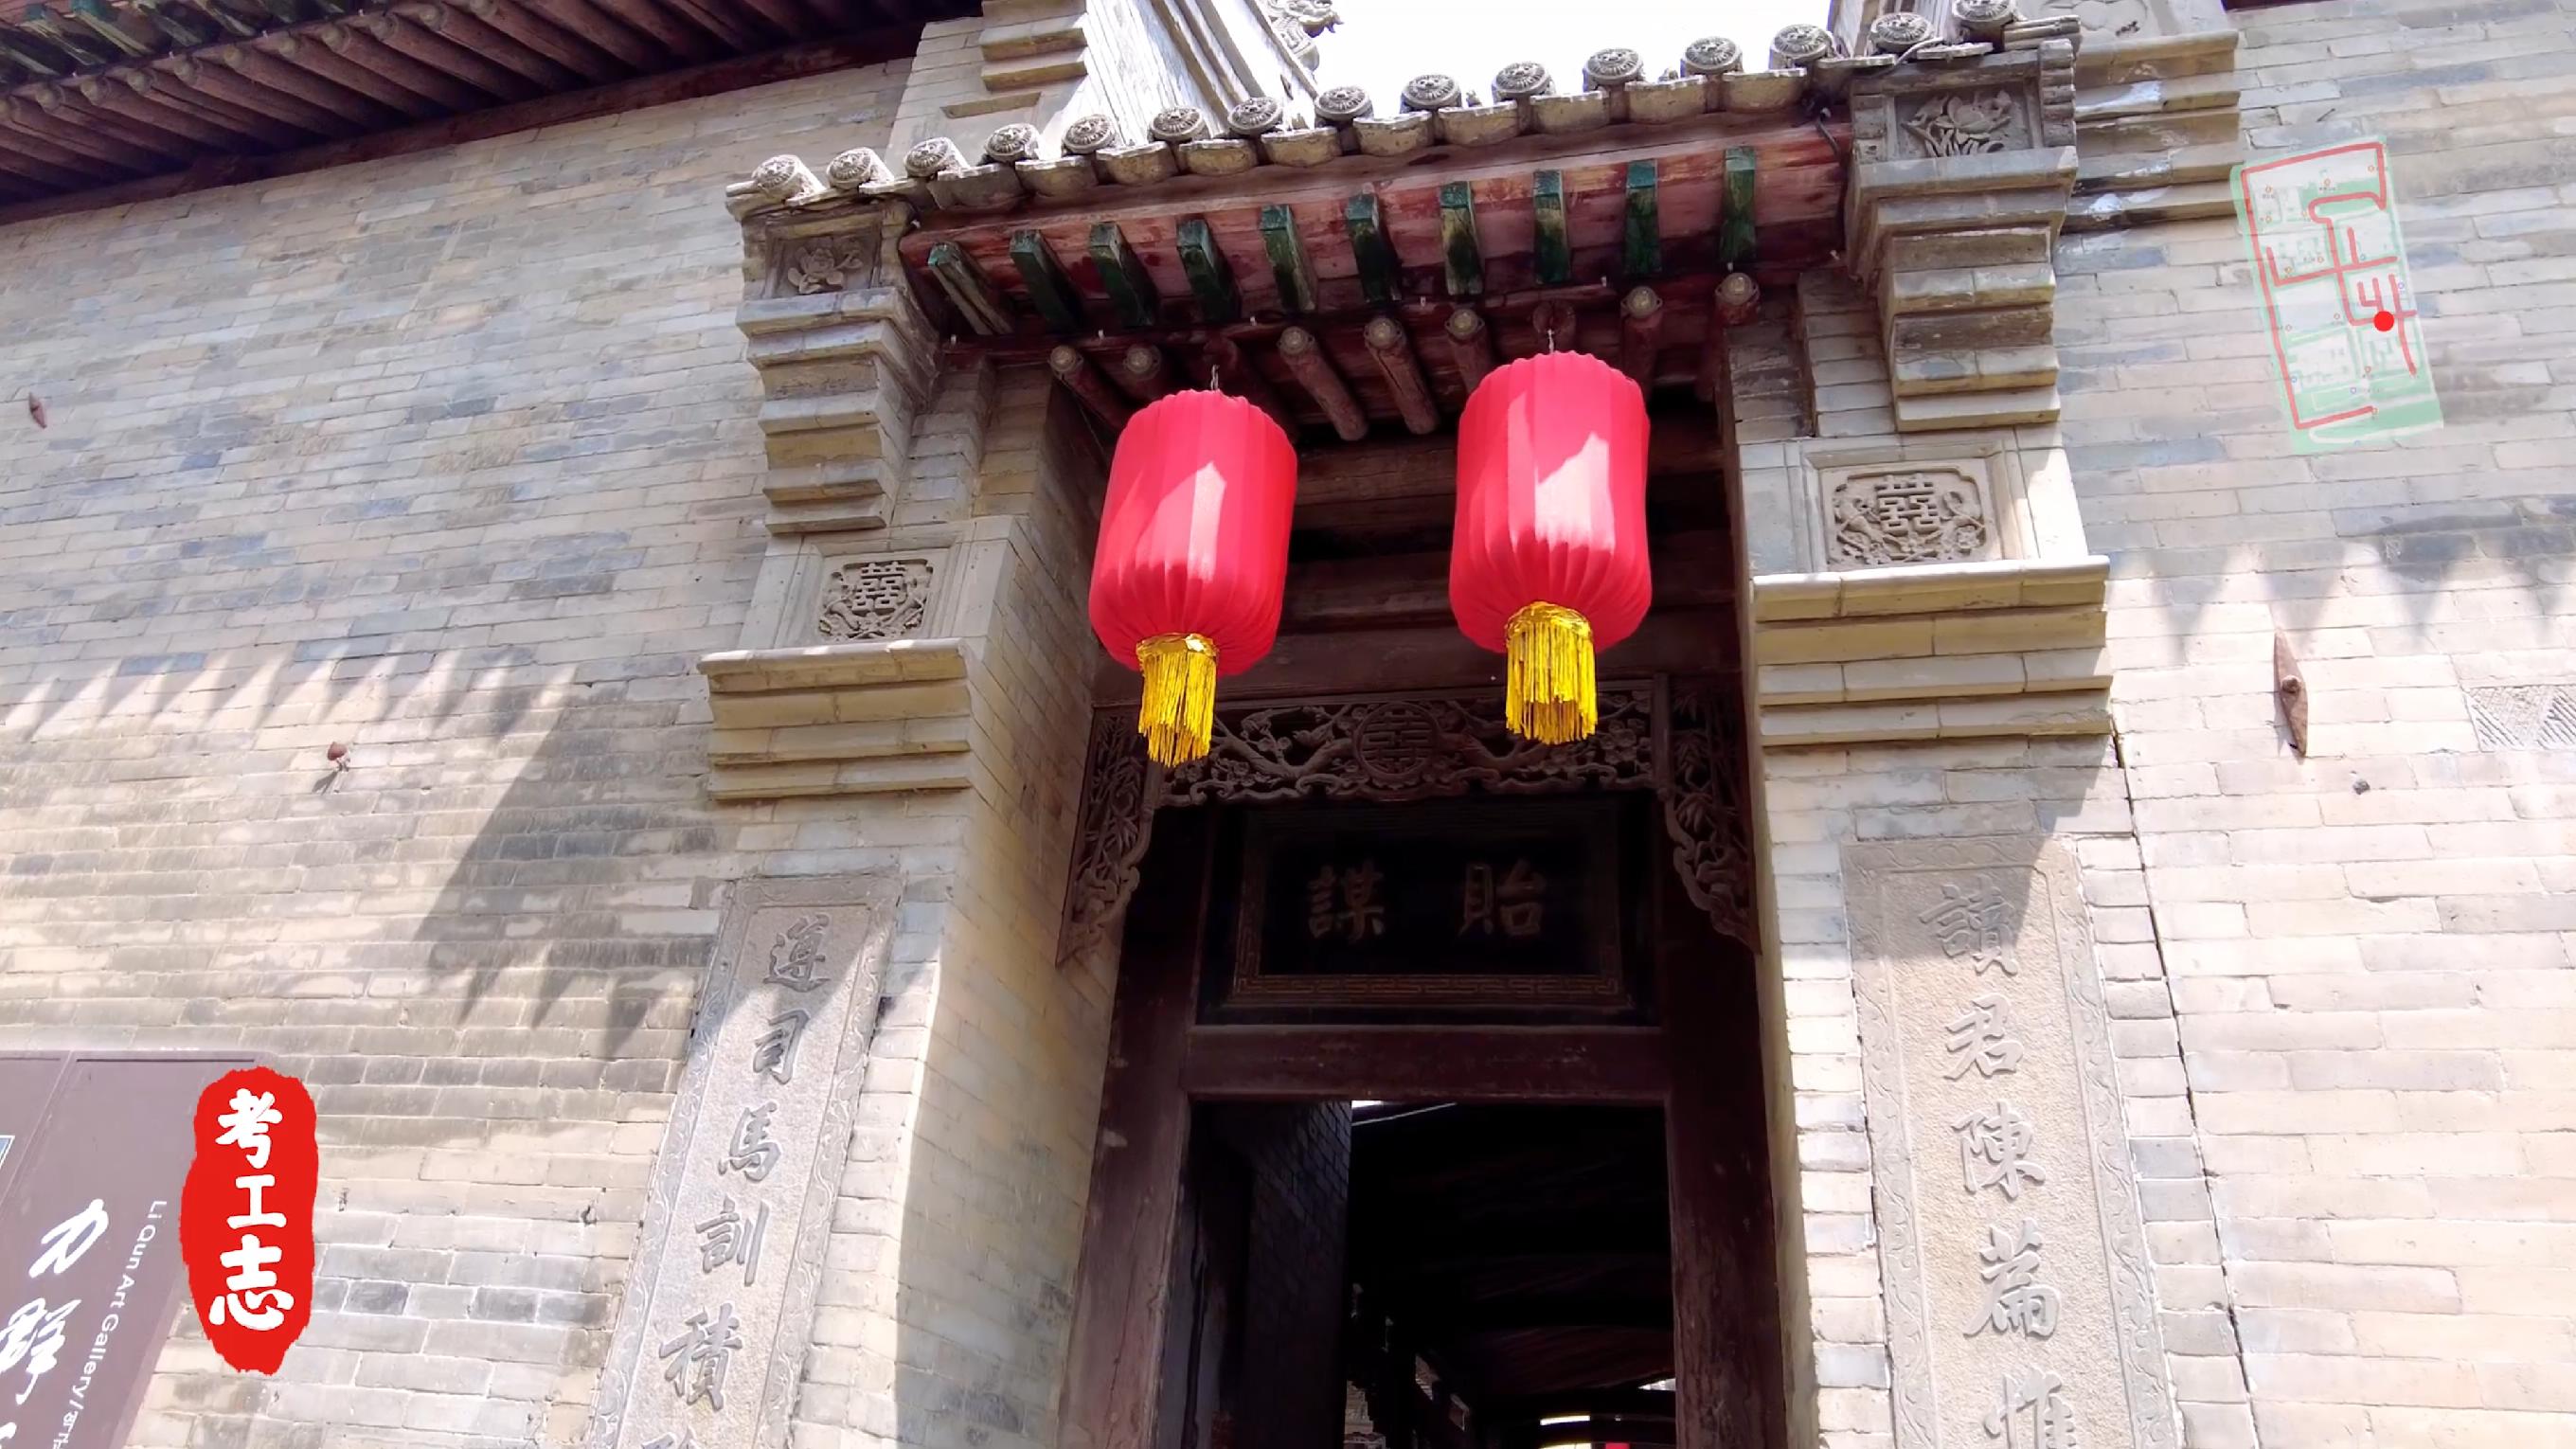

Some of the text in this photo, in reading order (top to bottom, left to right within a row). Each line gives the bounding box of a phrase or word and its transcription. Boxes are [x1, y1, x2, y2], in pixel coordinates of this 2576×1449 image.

[641, 912, 832, 1449] 遵司馬訓積
[147, 1200, 168, 1219] Li
[125, 1224, 156, 1269] Qun
[109, 1273, 134, 1309] Art
